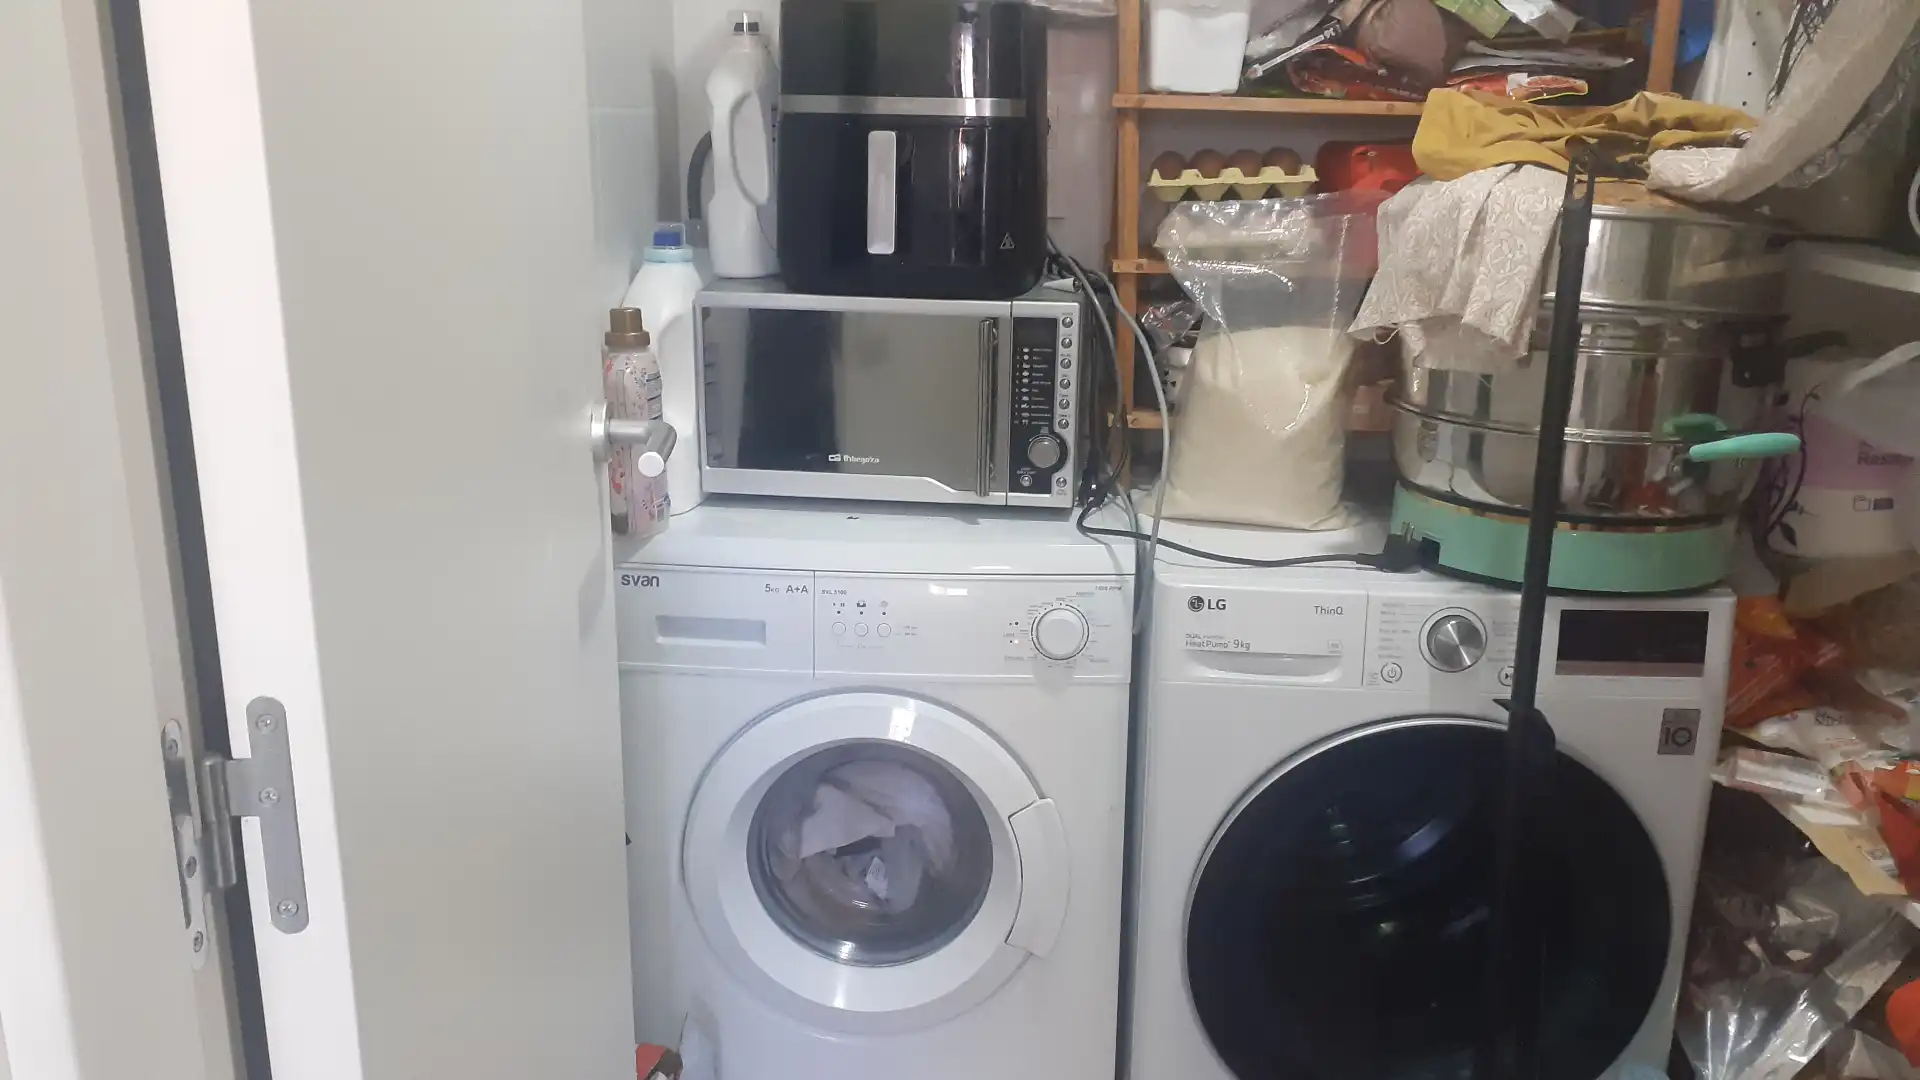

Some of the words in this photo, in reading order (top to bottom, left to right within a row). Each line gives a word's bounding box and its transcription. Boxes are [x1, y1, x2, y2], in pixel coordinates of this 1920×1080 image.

[620, 573, 660, 588] svan
[785, 584, 809, 594] A+A
[1207, 598, 1227, 611] LG
[1313, 605, 1344, 616] ThinQ
